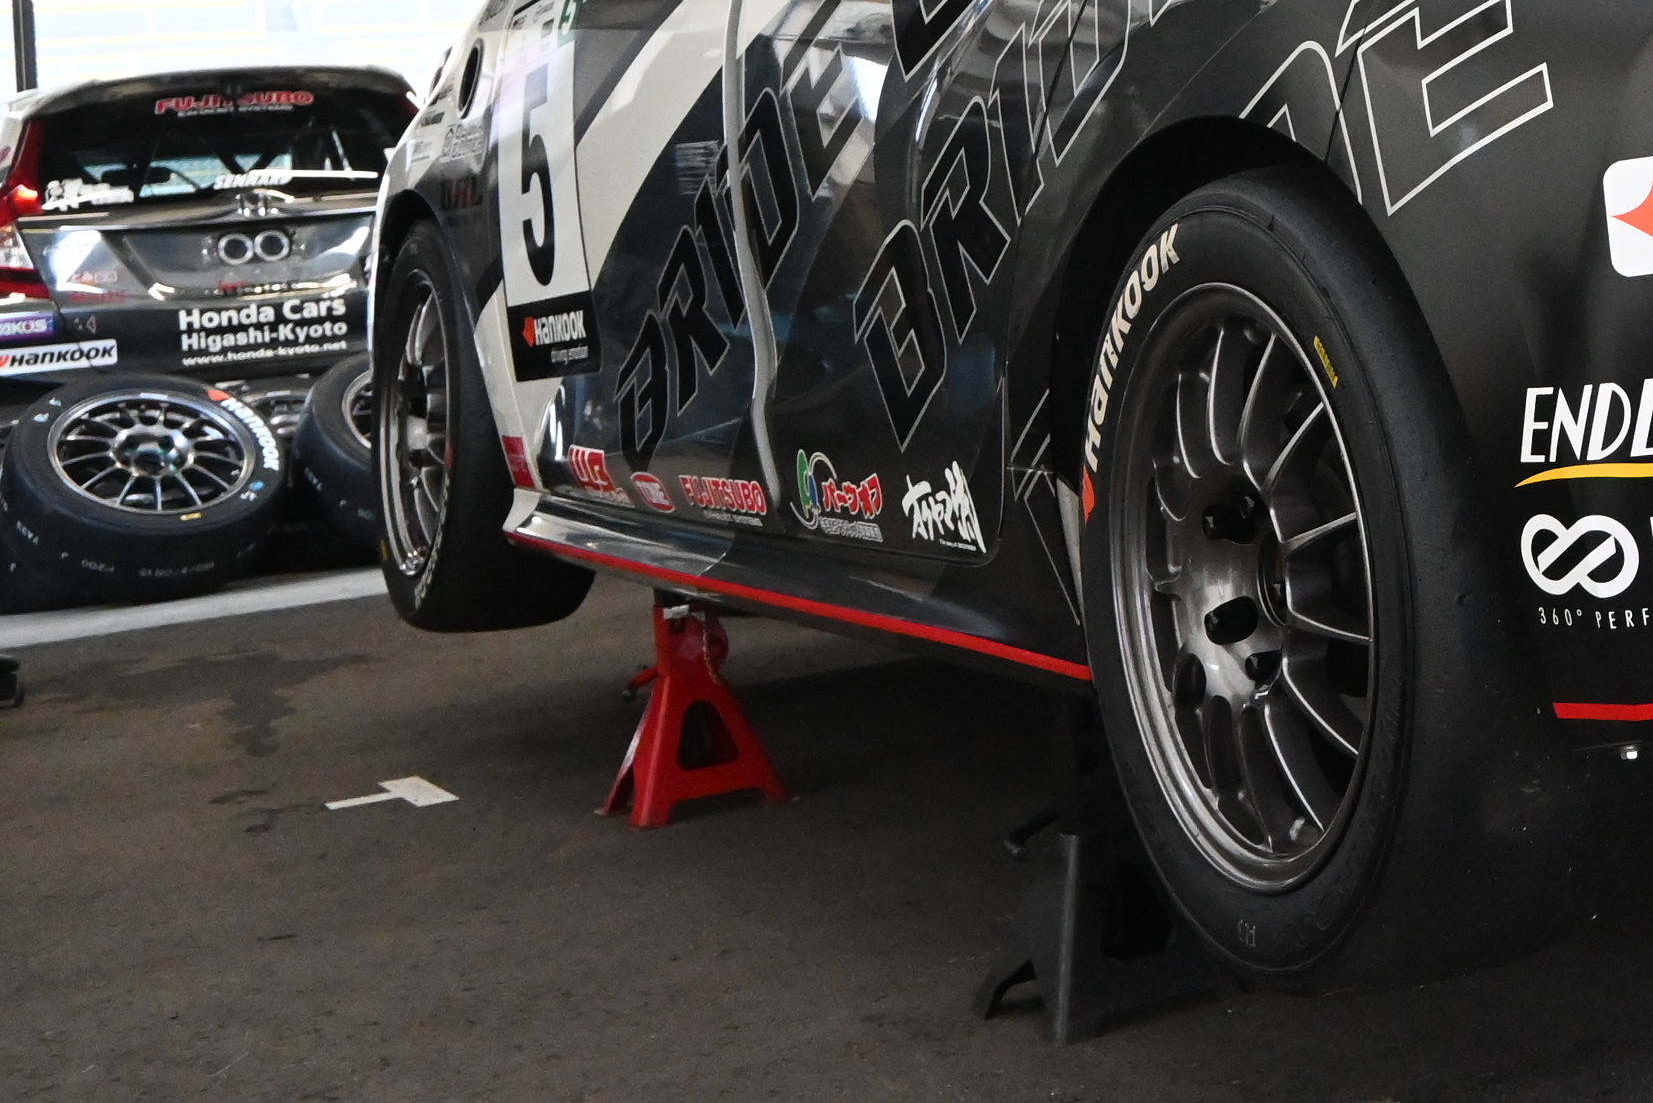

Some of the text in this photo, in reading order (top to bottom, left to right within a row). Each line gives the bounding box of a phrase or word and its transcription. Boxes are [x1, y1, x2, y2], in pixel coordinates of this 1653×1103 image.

[521, 63, 555, 287] 5
[179, 297, 347, 332] Honda Cars
[181, 319, 348, 353] Higashi-Kyoto
[181, 340, 347, 367] www.honda-kyoto.net
[679, 474, 767, 516] FUJITSUBO
[1538, 606, 1583, 627] 360°
